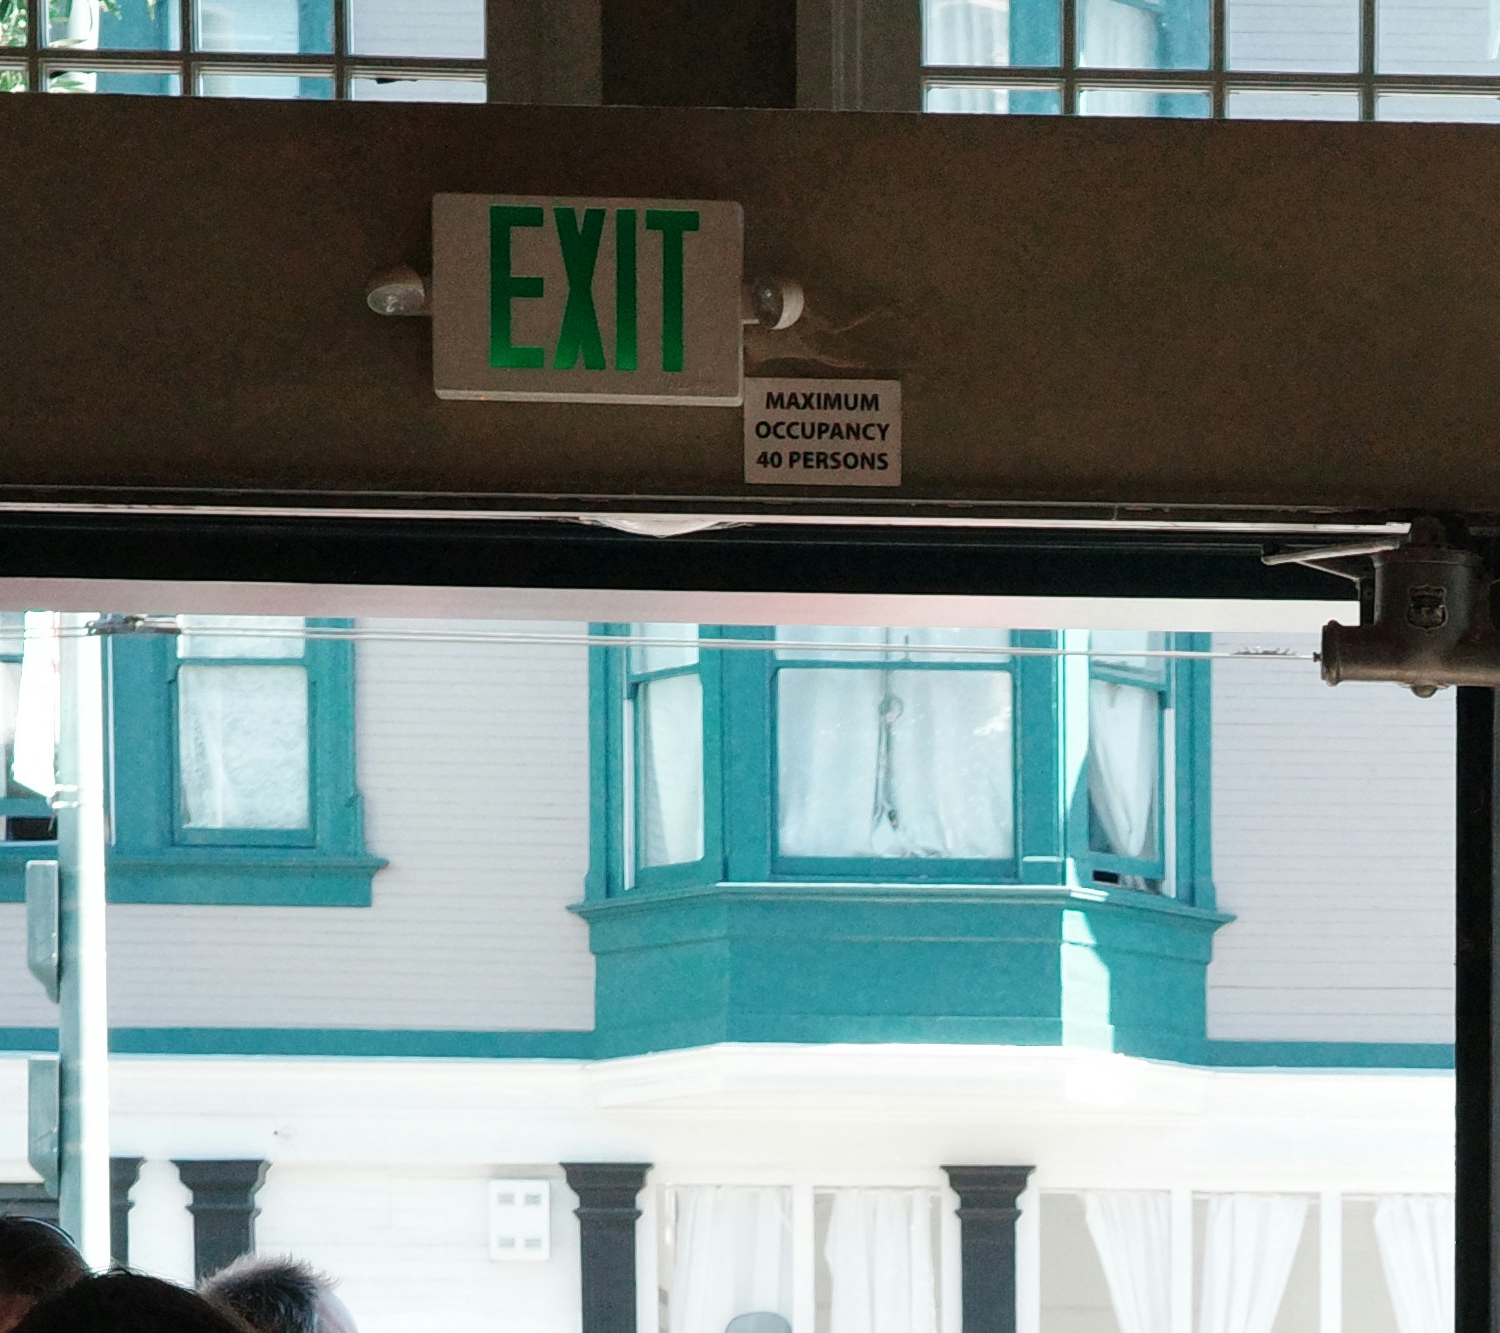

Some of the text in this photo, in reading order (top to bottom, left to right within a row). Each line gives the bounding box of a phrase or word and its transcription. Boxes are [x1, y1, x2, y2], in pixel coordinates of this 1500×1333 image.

[489, 205, 700, 372] EXIT
[765, 391, 879, 411] MAXIMUM
[755, 421, 890, 441] OCCUPANCY
[756, 451, 888, 470] 40 PERSONS
